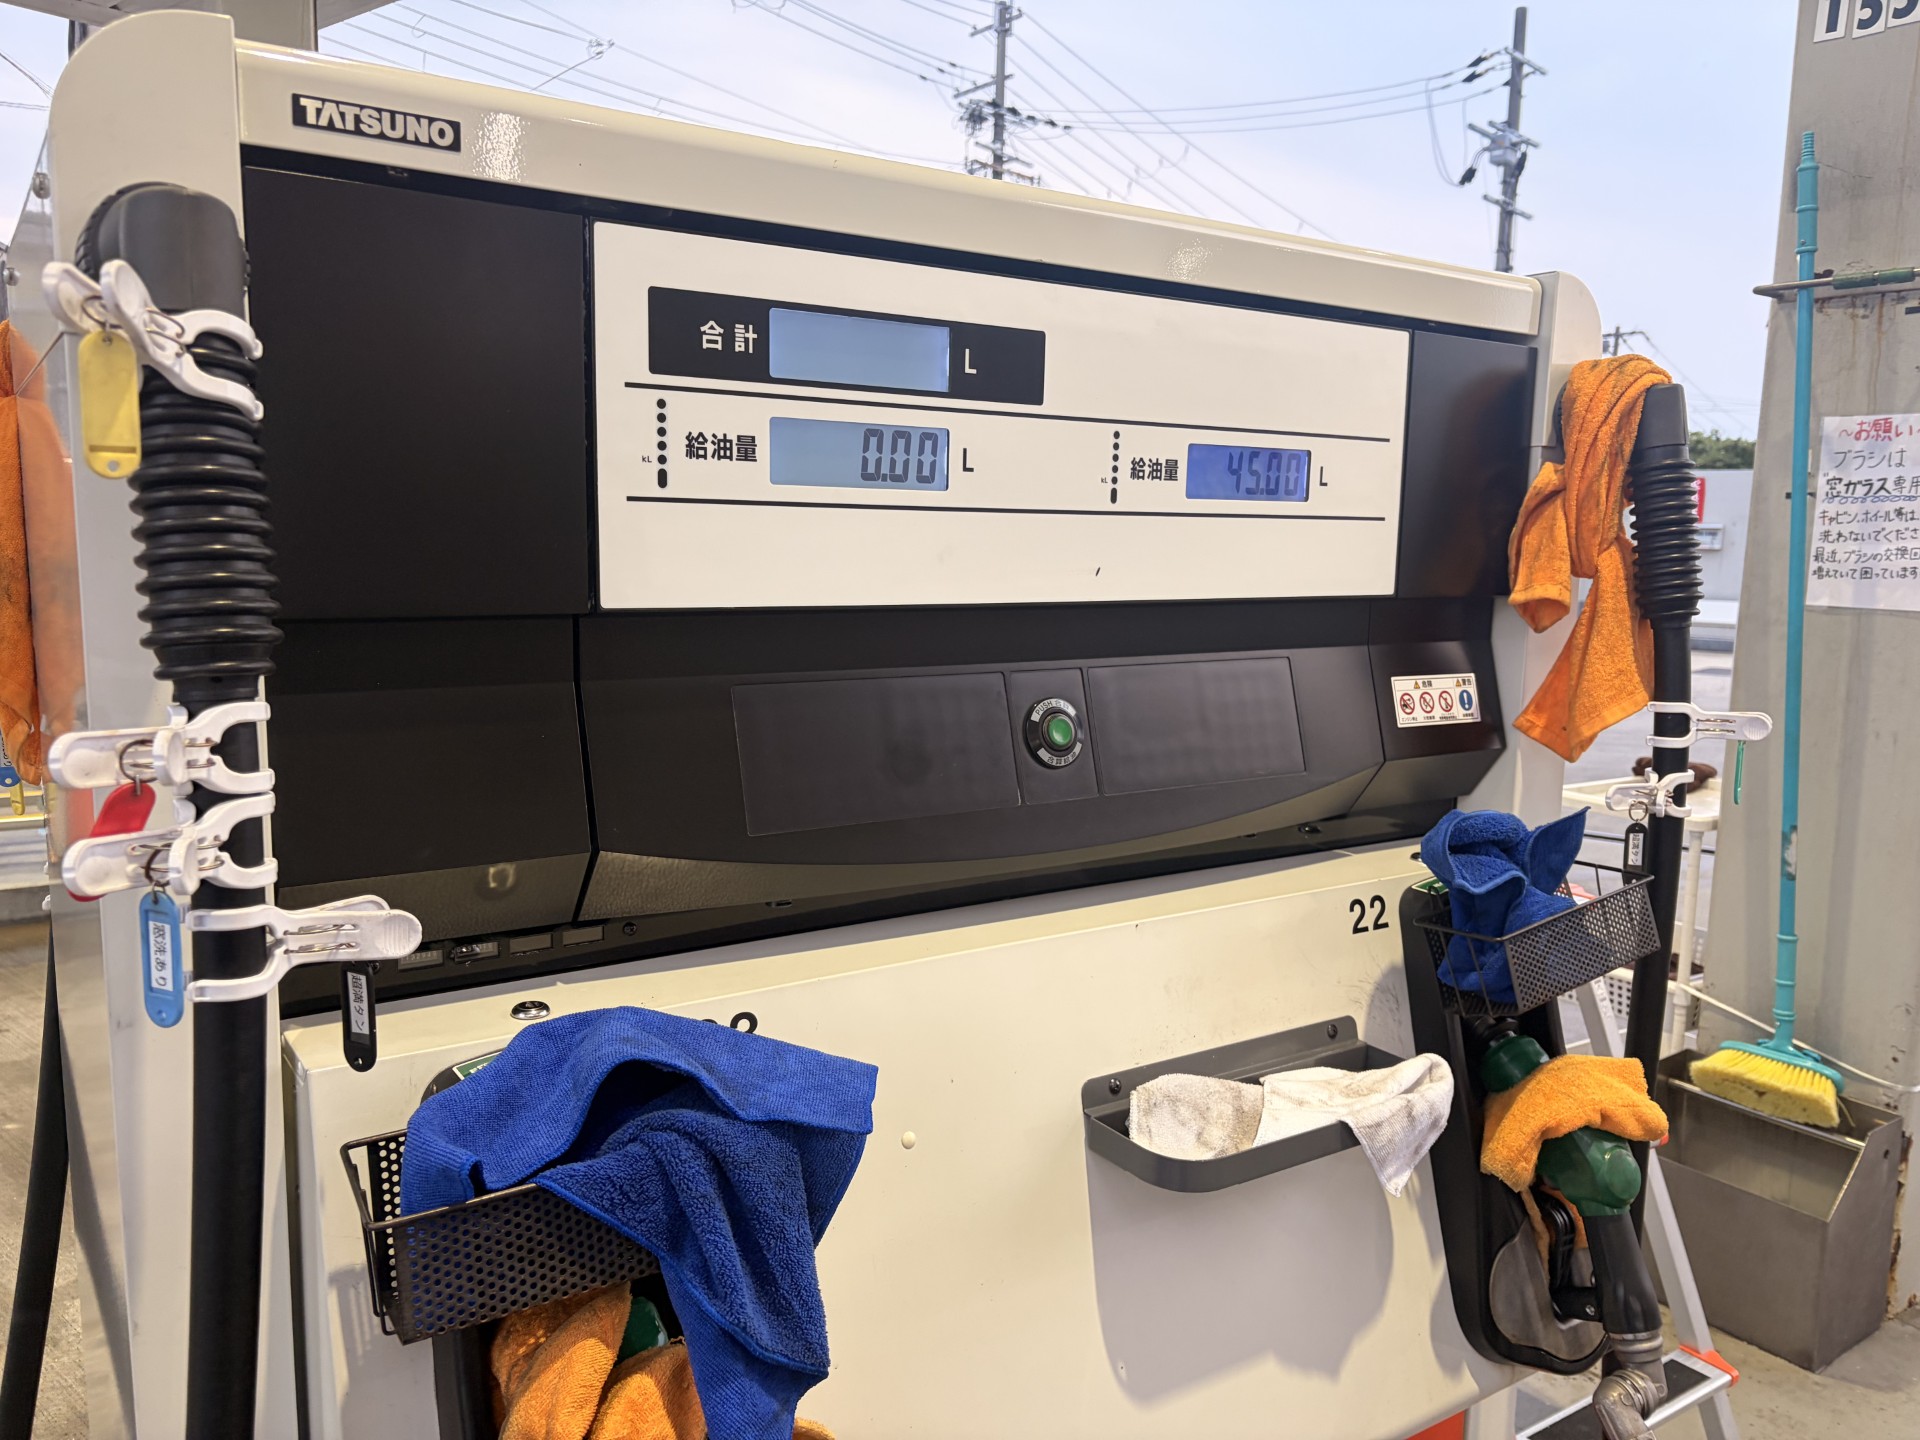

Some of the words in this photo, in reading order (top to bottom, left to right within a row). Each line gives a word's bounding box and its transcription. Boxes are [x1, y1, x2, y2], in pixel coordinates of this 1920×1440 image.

[299, 97, 455, 147] TATSUNO
[700, 320, 758, 354] 合計
[964, 348, 977, 375] L
[641, 455, 652, 464] kL
[684, 430, 758, 463] 給油量
[860, 427, 939, 484] 0.00
[962, 447, 974, 473] L
[1833, 447, 1907, 471] ブラシは
[1130, 457, 1179, 482] 給油量
[1227, 452, 1300, 495] 45.00
[1319, 466, 1328, 487] L
[1034, 700, 1053, 715] PUSH
[1349, 895, 1389, 935] 22
